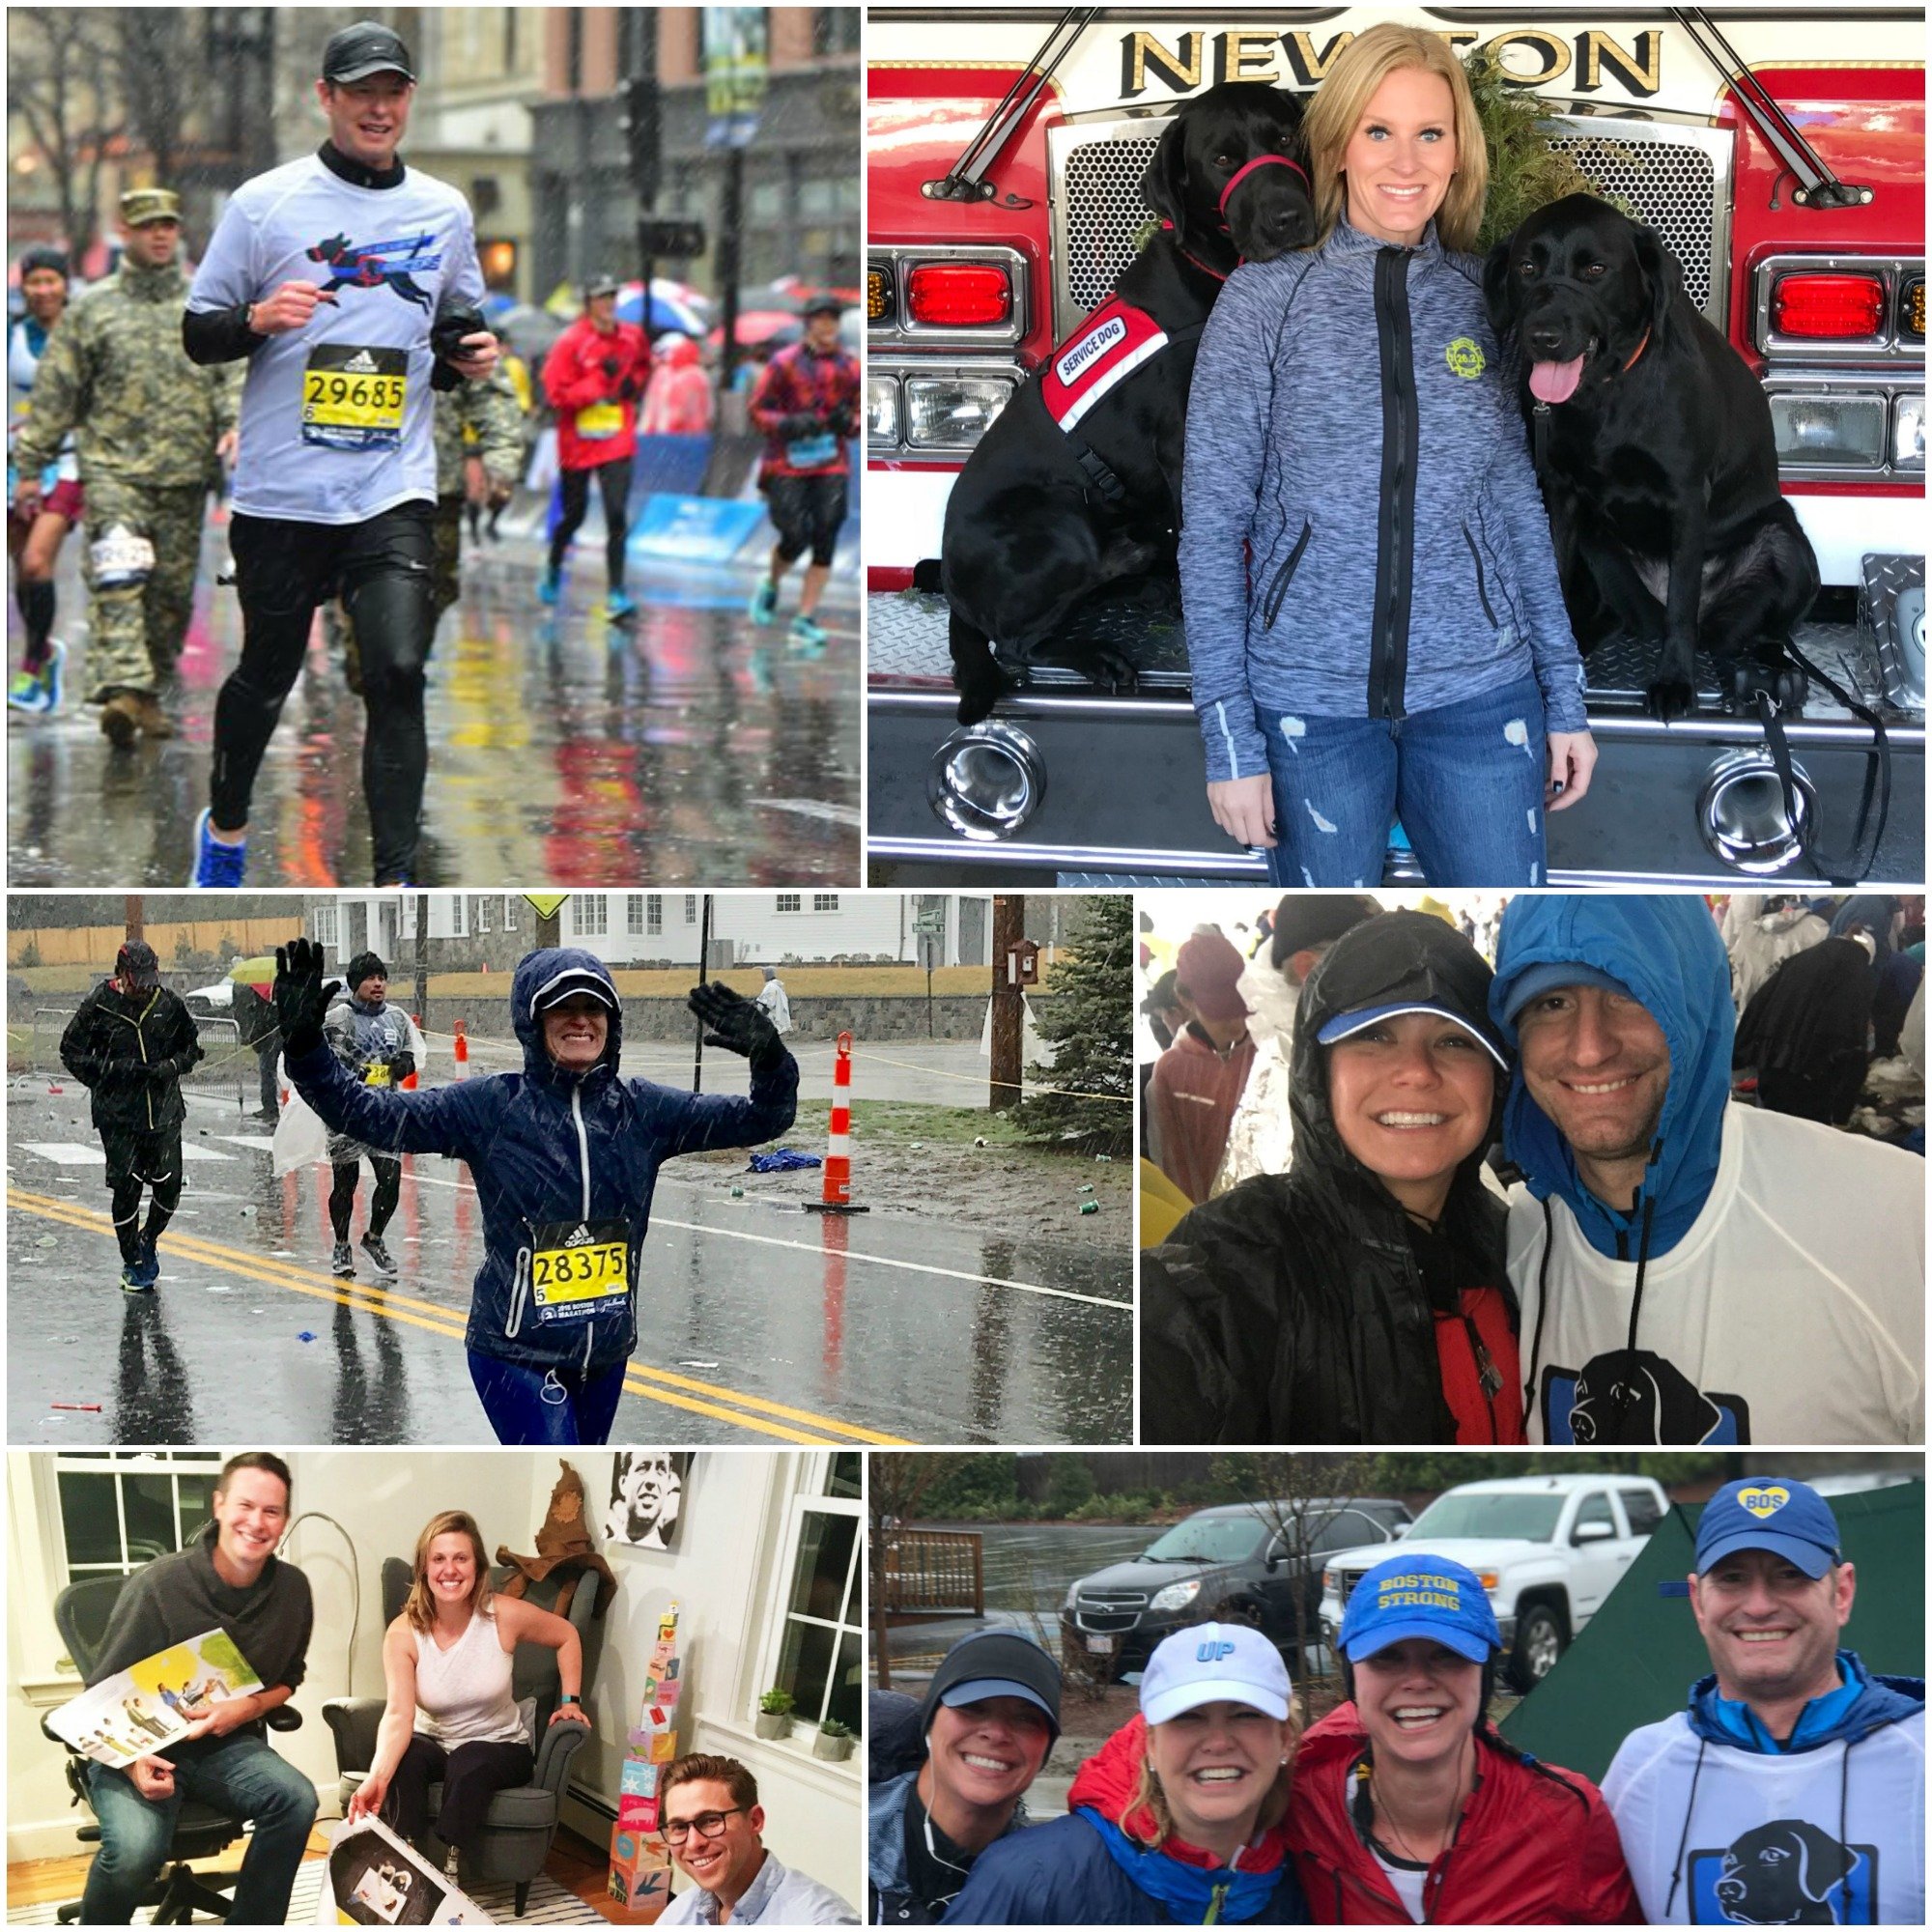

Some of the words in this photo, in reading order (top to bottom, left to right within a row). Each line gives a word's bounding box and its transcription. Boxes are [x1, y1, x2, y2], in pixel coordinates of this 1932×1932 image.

[1063, 337, 1100, 376] SERVICE
[1098, 323, 1121, 346] DOG
[308, 376, 403, 409] 29685
[564, 1236, 595, 1248] adidas
[535, 1247, 623, 1286] 28375
[536, 1289, 546, 1302] 5
[1746, 1493, 1783, 1509] BOS
[1378, 1575, 1459, 1593] BOSTON
[1378, 1592, 1461, 1610] STRONG
[1197, 1641, 1235, 1662] UP
